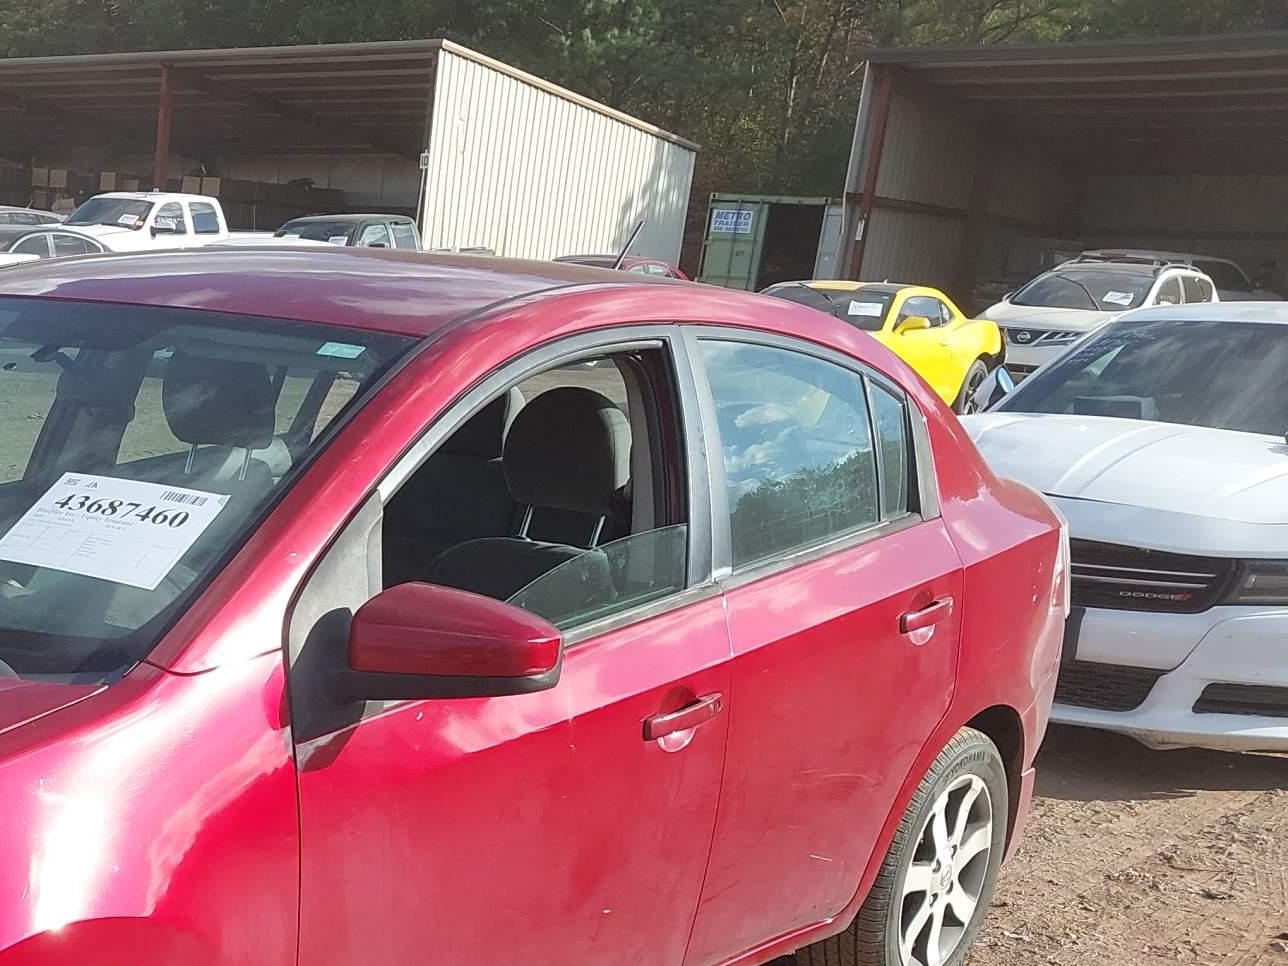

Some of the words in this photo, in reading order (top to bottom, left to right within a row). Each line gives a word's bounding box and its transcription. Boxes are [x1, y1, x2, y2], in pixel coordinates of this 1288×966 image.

[714, 211, 751, 220] METRO
[55, 494, 190, 528] 43687460
[1119, 591, 1183, 601] DODGE
[951, 751, 986, 776] YOKOHAMA
